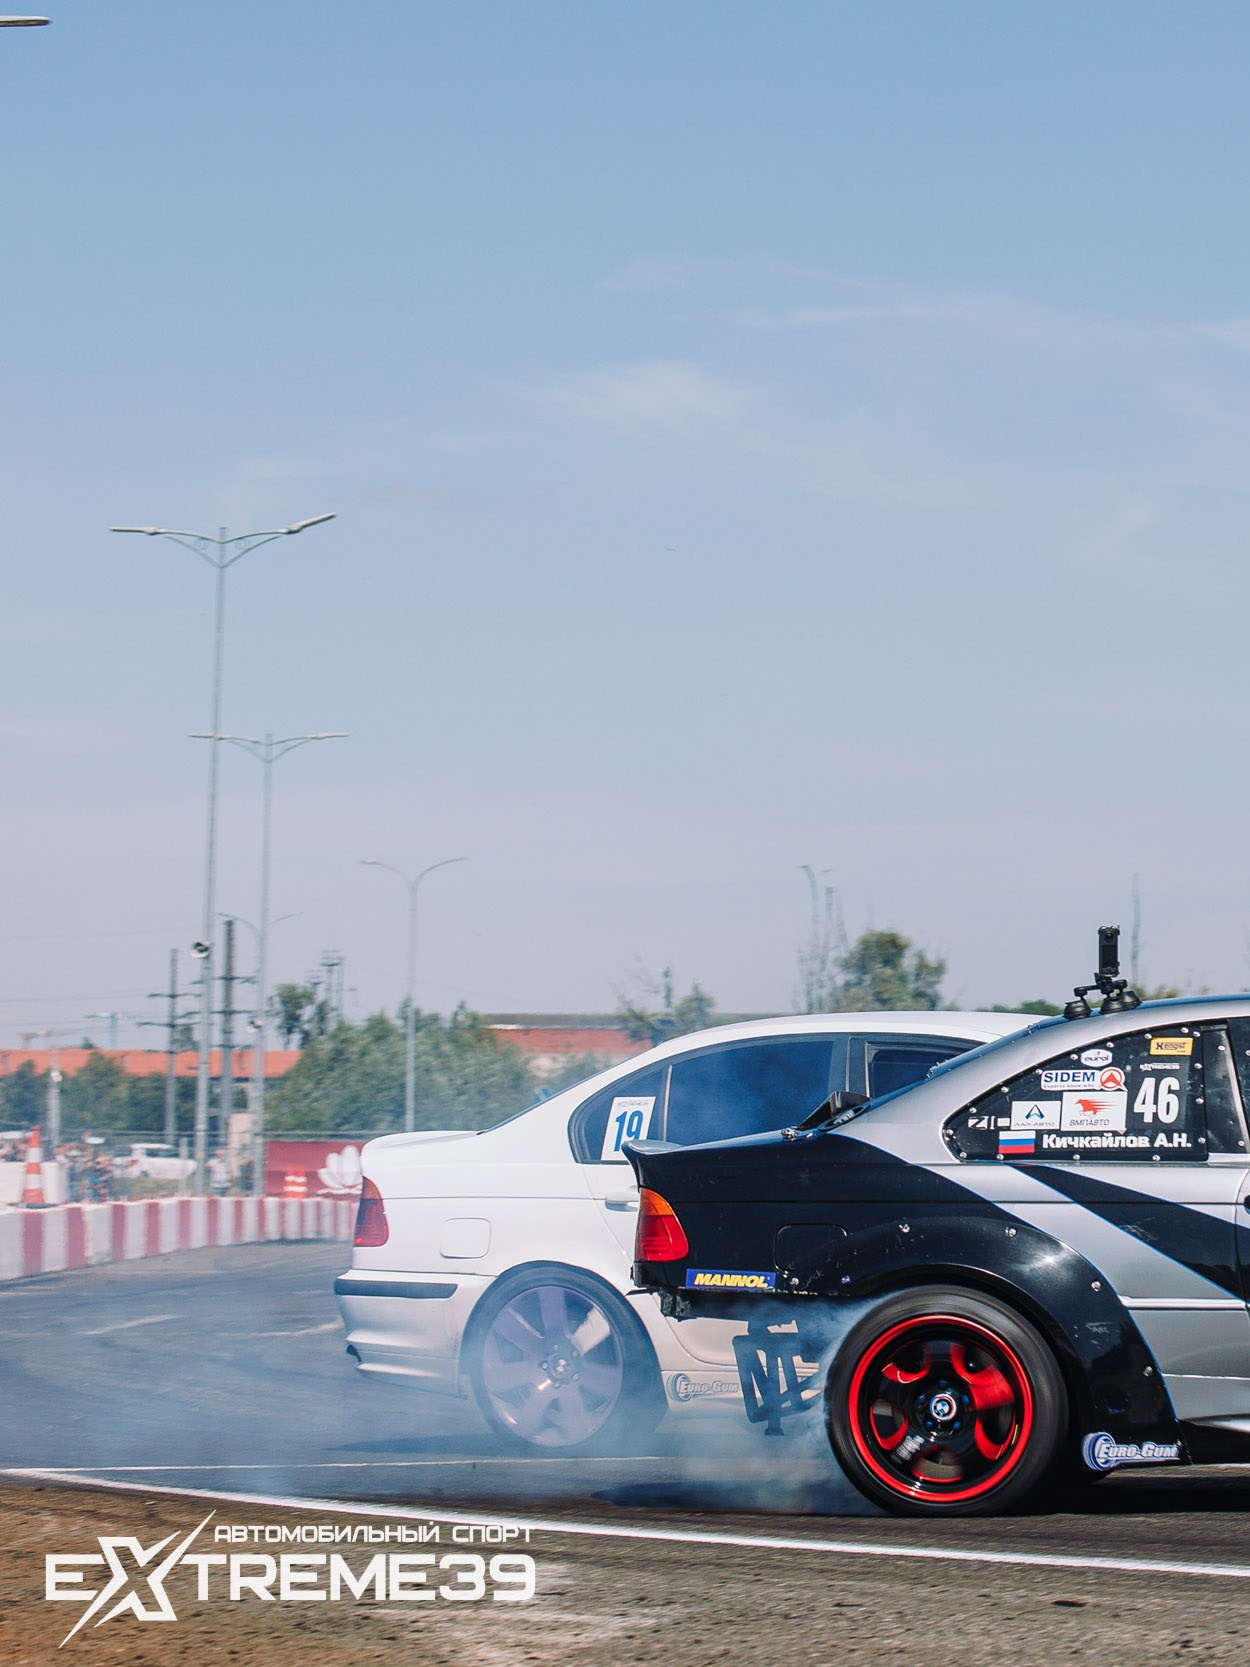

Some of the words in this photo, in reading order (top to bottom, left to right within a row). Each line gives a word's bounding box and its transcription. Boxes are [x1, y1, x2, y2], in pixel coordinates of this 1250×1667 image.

[1043, 1071, 1096, 1083] SIDEM
[1134, 1076, 1180, 1124] 46
[613, 1110, 644, 1152] 19
[1042, 1132, 1150, 1148] Кичкайлов
[1154, 1133, 1192, 1148] А.Н.
[693, 1272, 768, 1288] MANNOL
